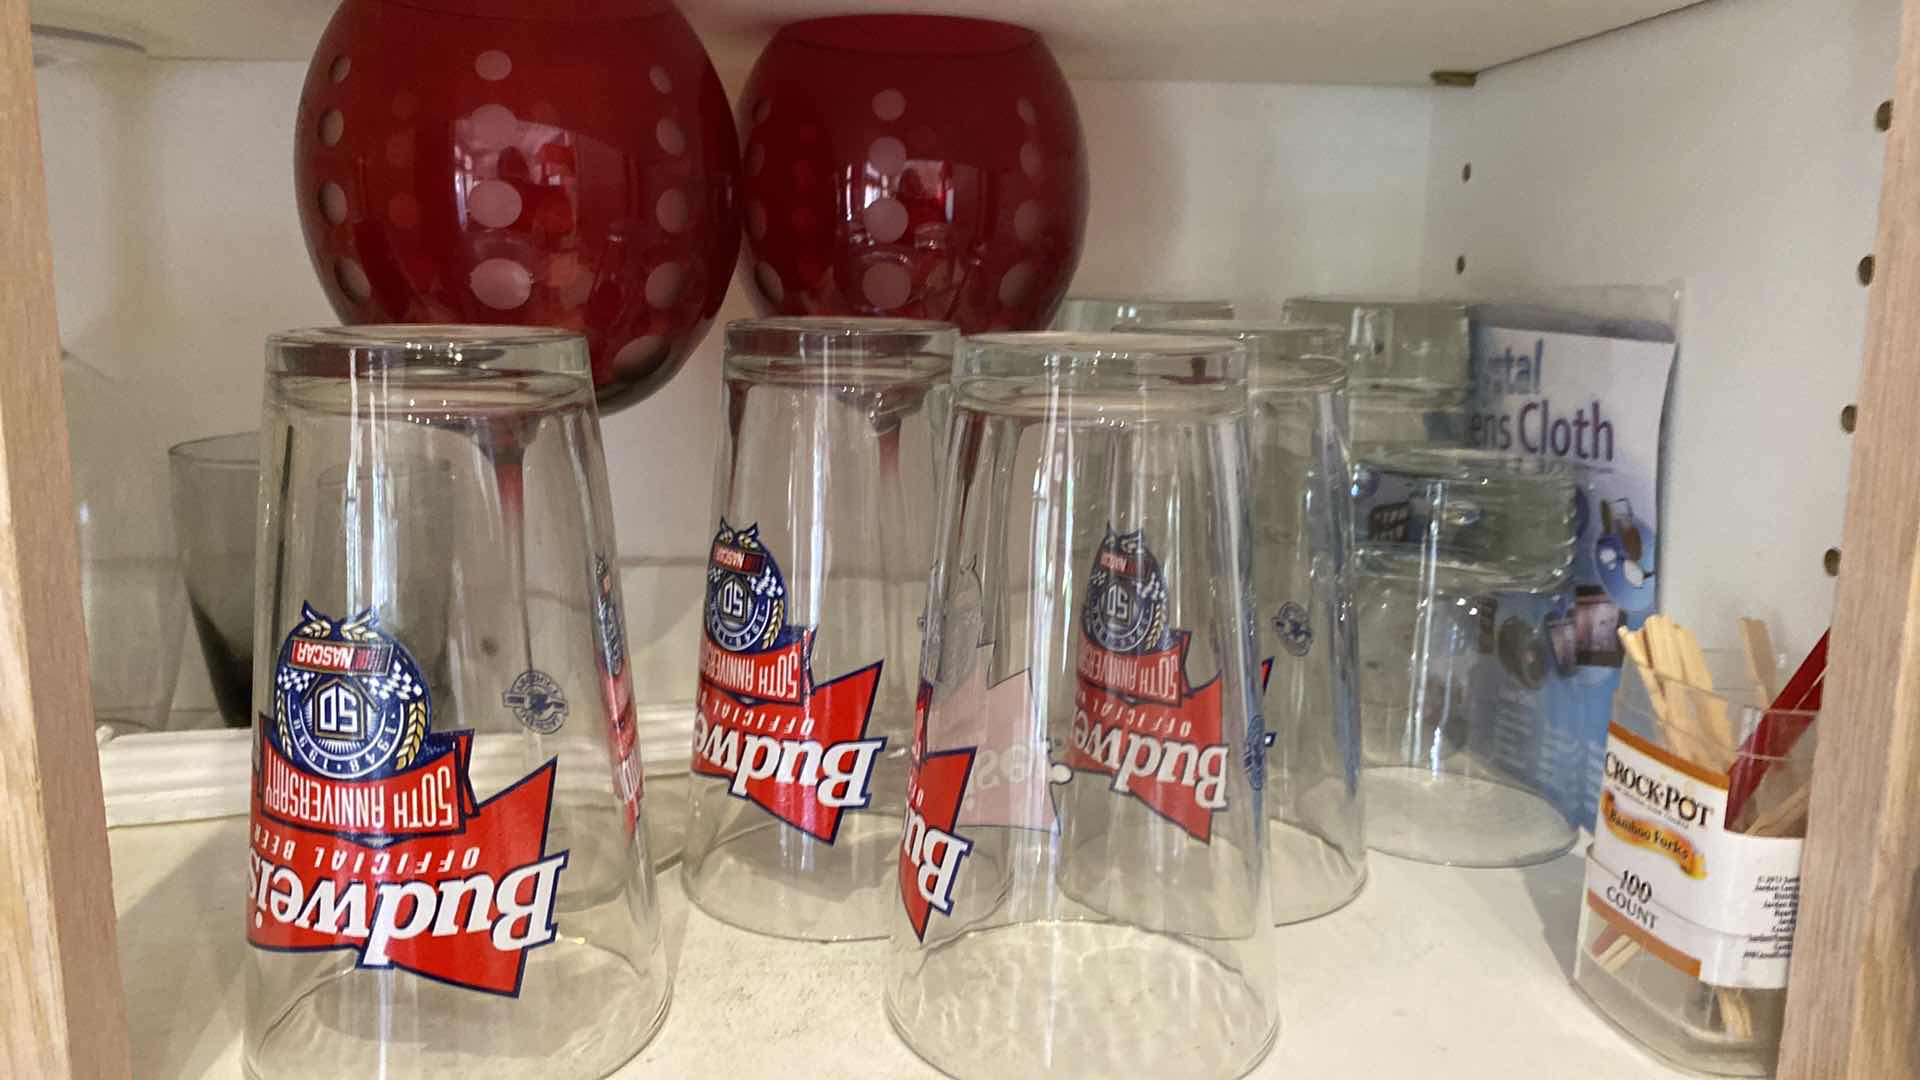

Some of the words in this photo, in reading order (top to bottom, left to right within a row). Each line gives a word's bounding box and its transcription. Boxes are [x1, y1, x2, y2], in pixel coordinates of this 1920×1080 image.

[1469, 413, 1512, 450] ens
[1519, 400, 1615, 462] Cloth
[295, 642, 355, 670] NASCAR
[758, 650, 799, 699] 50TH
[1139, 654, 1179, 702] 50TH
[318, 684, 359, 733] 50
[712, 699, 815, 736] OFFICIAL
[694, 711, 885, 807] Budwe
[1072, 708, 1229, 809] Budwe
[265, 750, 385, 829] ANNIVERSARY
[393, 766, 453, 829] 50TH
[254, 823, 297, 861] BEER
[1608, 808, 1652, 840] Bamboo
[1653, 829, 1691, 860] Forks
[313, 846, 481, 876] OFFICIAL
[247, 848, 566, 966] Budweis
[1606, 886, 1660, 929] COUNT
[1620, 870, 1652, 904] 100
